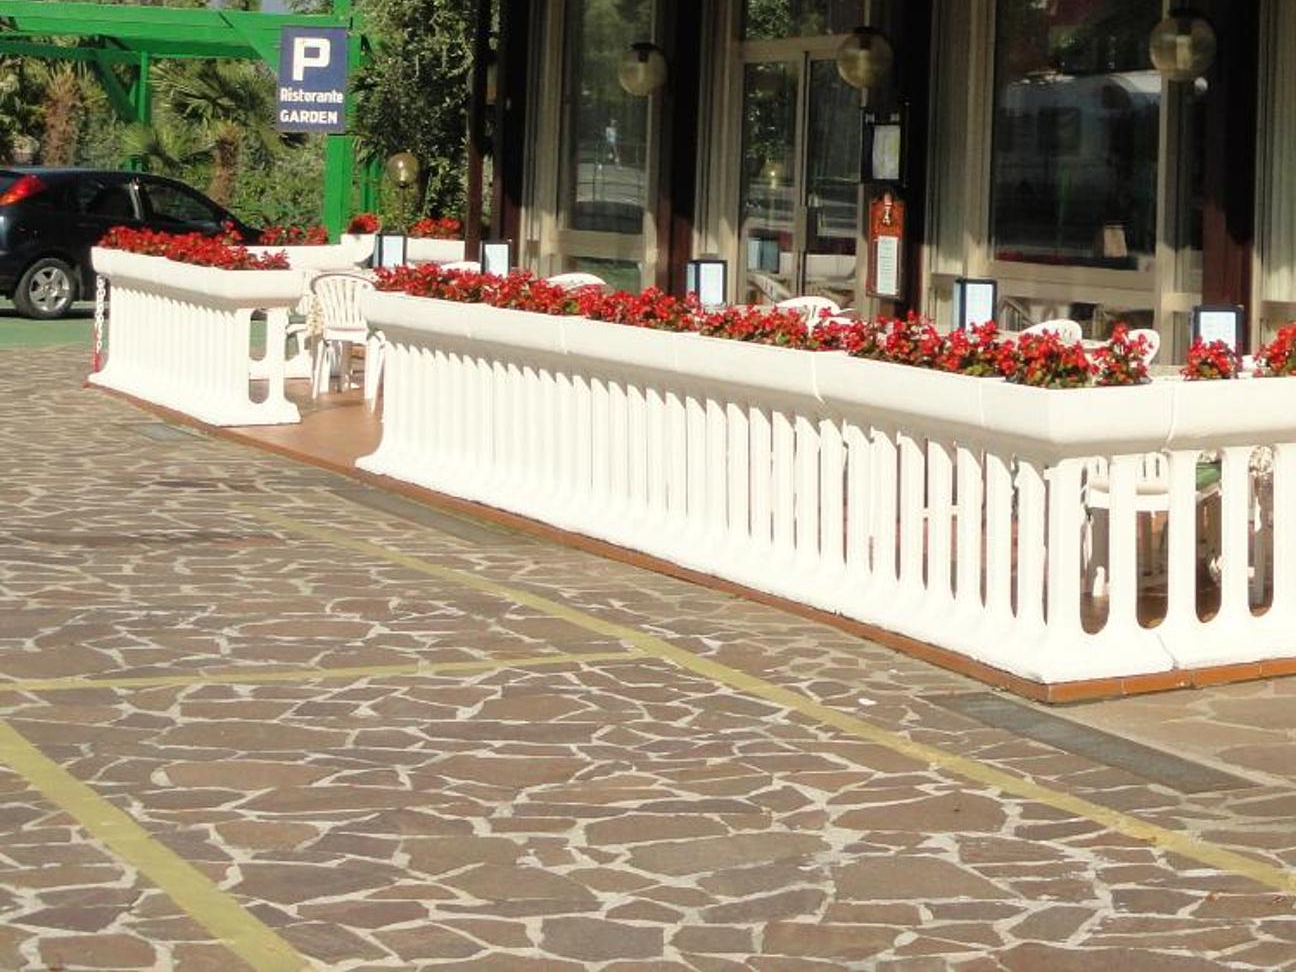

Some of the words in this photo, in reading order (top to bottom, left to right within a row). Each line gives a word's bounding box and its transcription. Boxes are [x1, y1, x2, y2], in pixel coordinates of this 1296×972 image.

[292, 37, 331, 81] P
[280, 87, 343, 103] Ristorante
[280, 109, 338, 124] GARDEN
